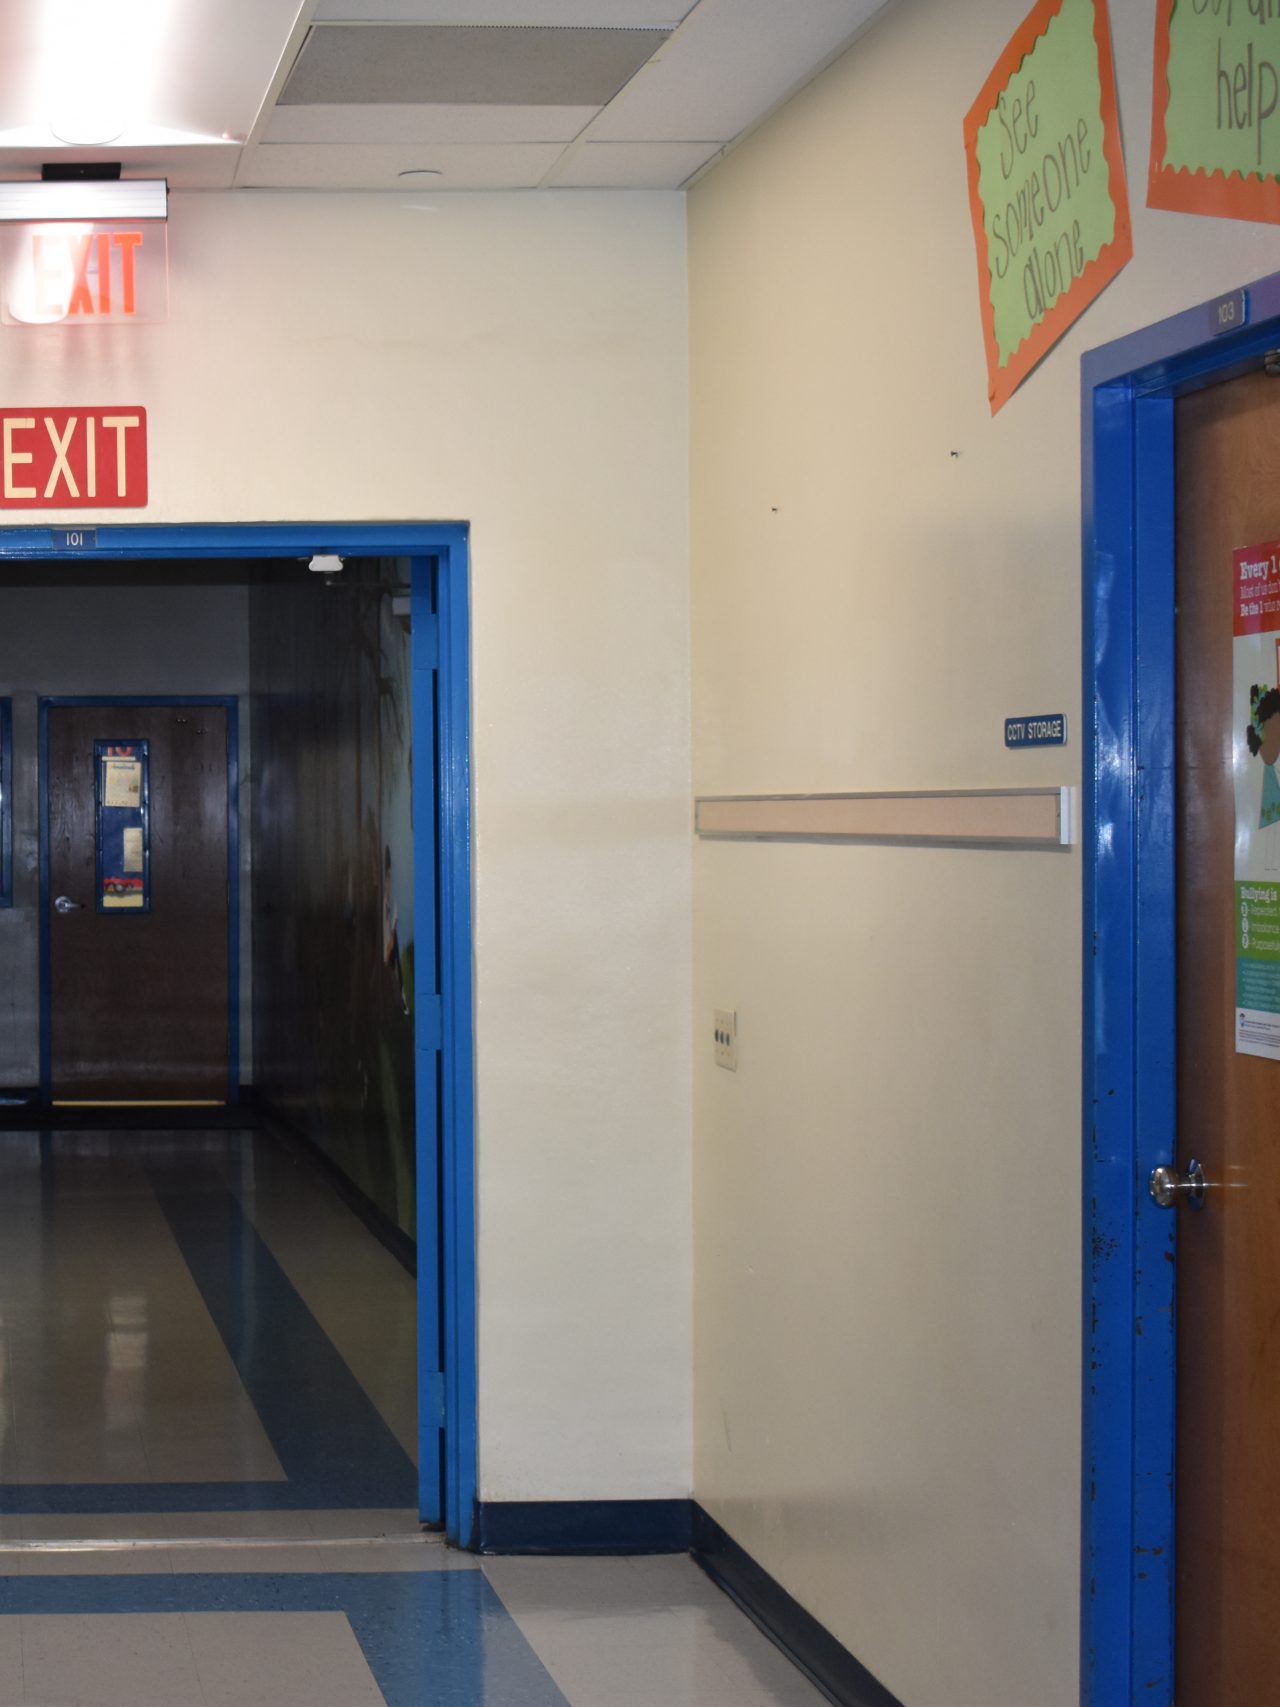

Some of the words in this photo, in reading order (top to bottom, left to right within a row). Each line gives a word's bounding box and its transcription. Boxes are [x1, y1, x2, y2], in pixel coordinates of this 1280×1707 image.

[1216, 37, 1280, 165] help
[31, 231, 144, 316] EXIT
[1022, 218, 1084, 320] alone
[1219, 301, 1235, 325] 103
[3, 416, 140, 498] EXIT
[1239, 561, 1269, 580] Every
[1028, 720, 1061, 739] STORAGE
